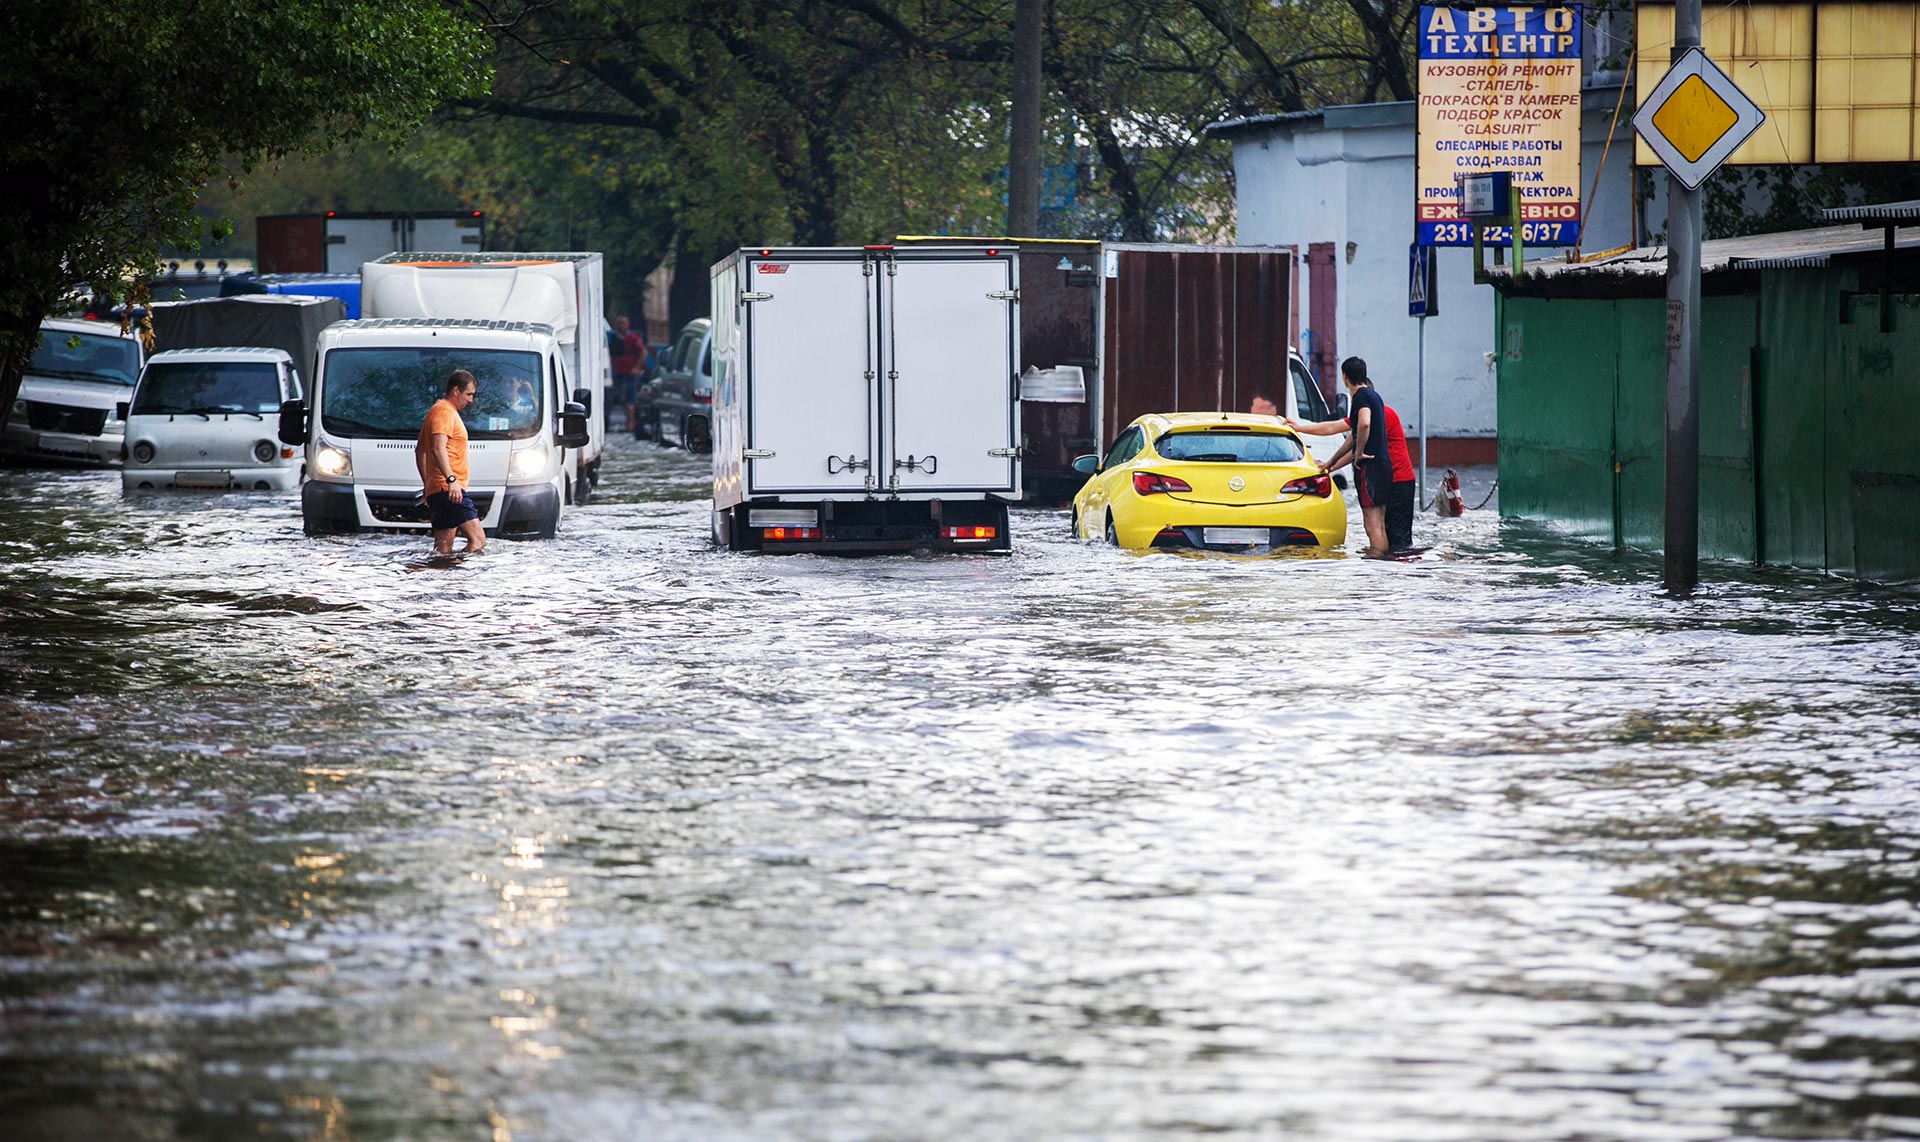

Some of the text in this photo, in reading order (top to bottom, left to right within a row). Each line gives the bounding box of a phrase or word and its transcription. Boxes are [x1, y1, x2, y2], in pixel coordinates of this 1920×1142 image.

[1428, 7, 1573, 33] АВТО
[1427, 35, 1573, 57] ТЕХЦЕНТР
[1427, 63, 1575, 76] КУЗОВНОЙ РЕМОНТ
[1461, 80, 1539, 91] -СТАПЕЛЬ-
[1421, 94, 1579, 106] ПОКРАСКА В КАМЕРЕ
[1437, 109, 1562, 121] ПОДБОР КРАСОК
[1458, 123, 1541, 135] "GLASURIT"
[1435, 140, 1562, 151] СЛЕСАРНЫЕ РАБОТЫ
[1456, 156, 1542, 168] СХОД-РАЗВАЛ
